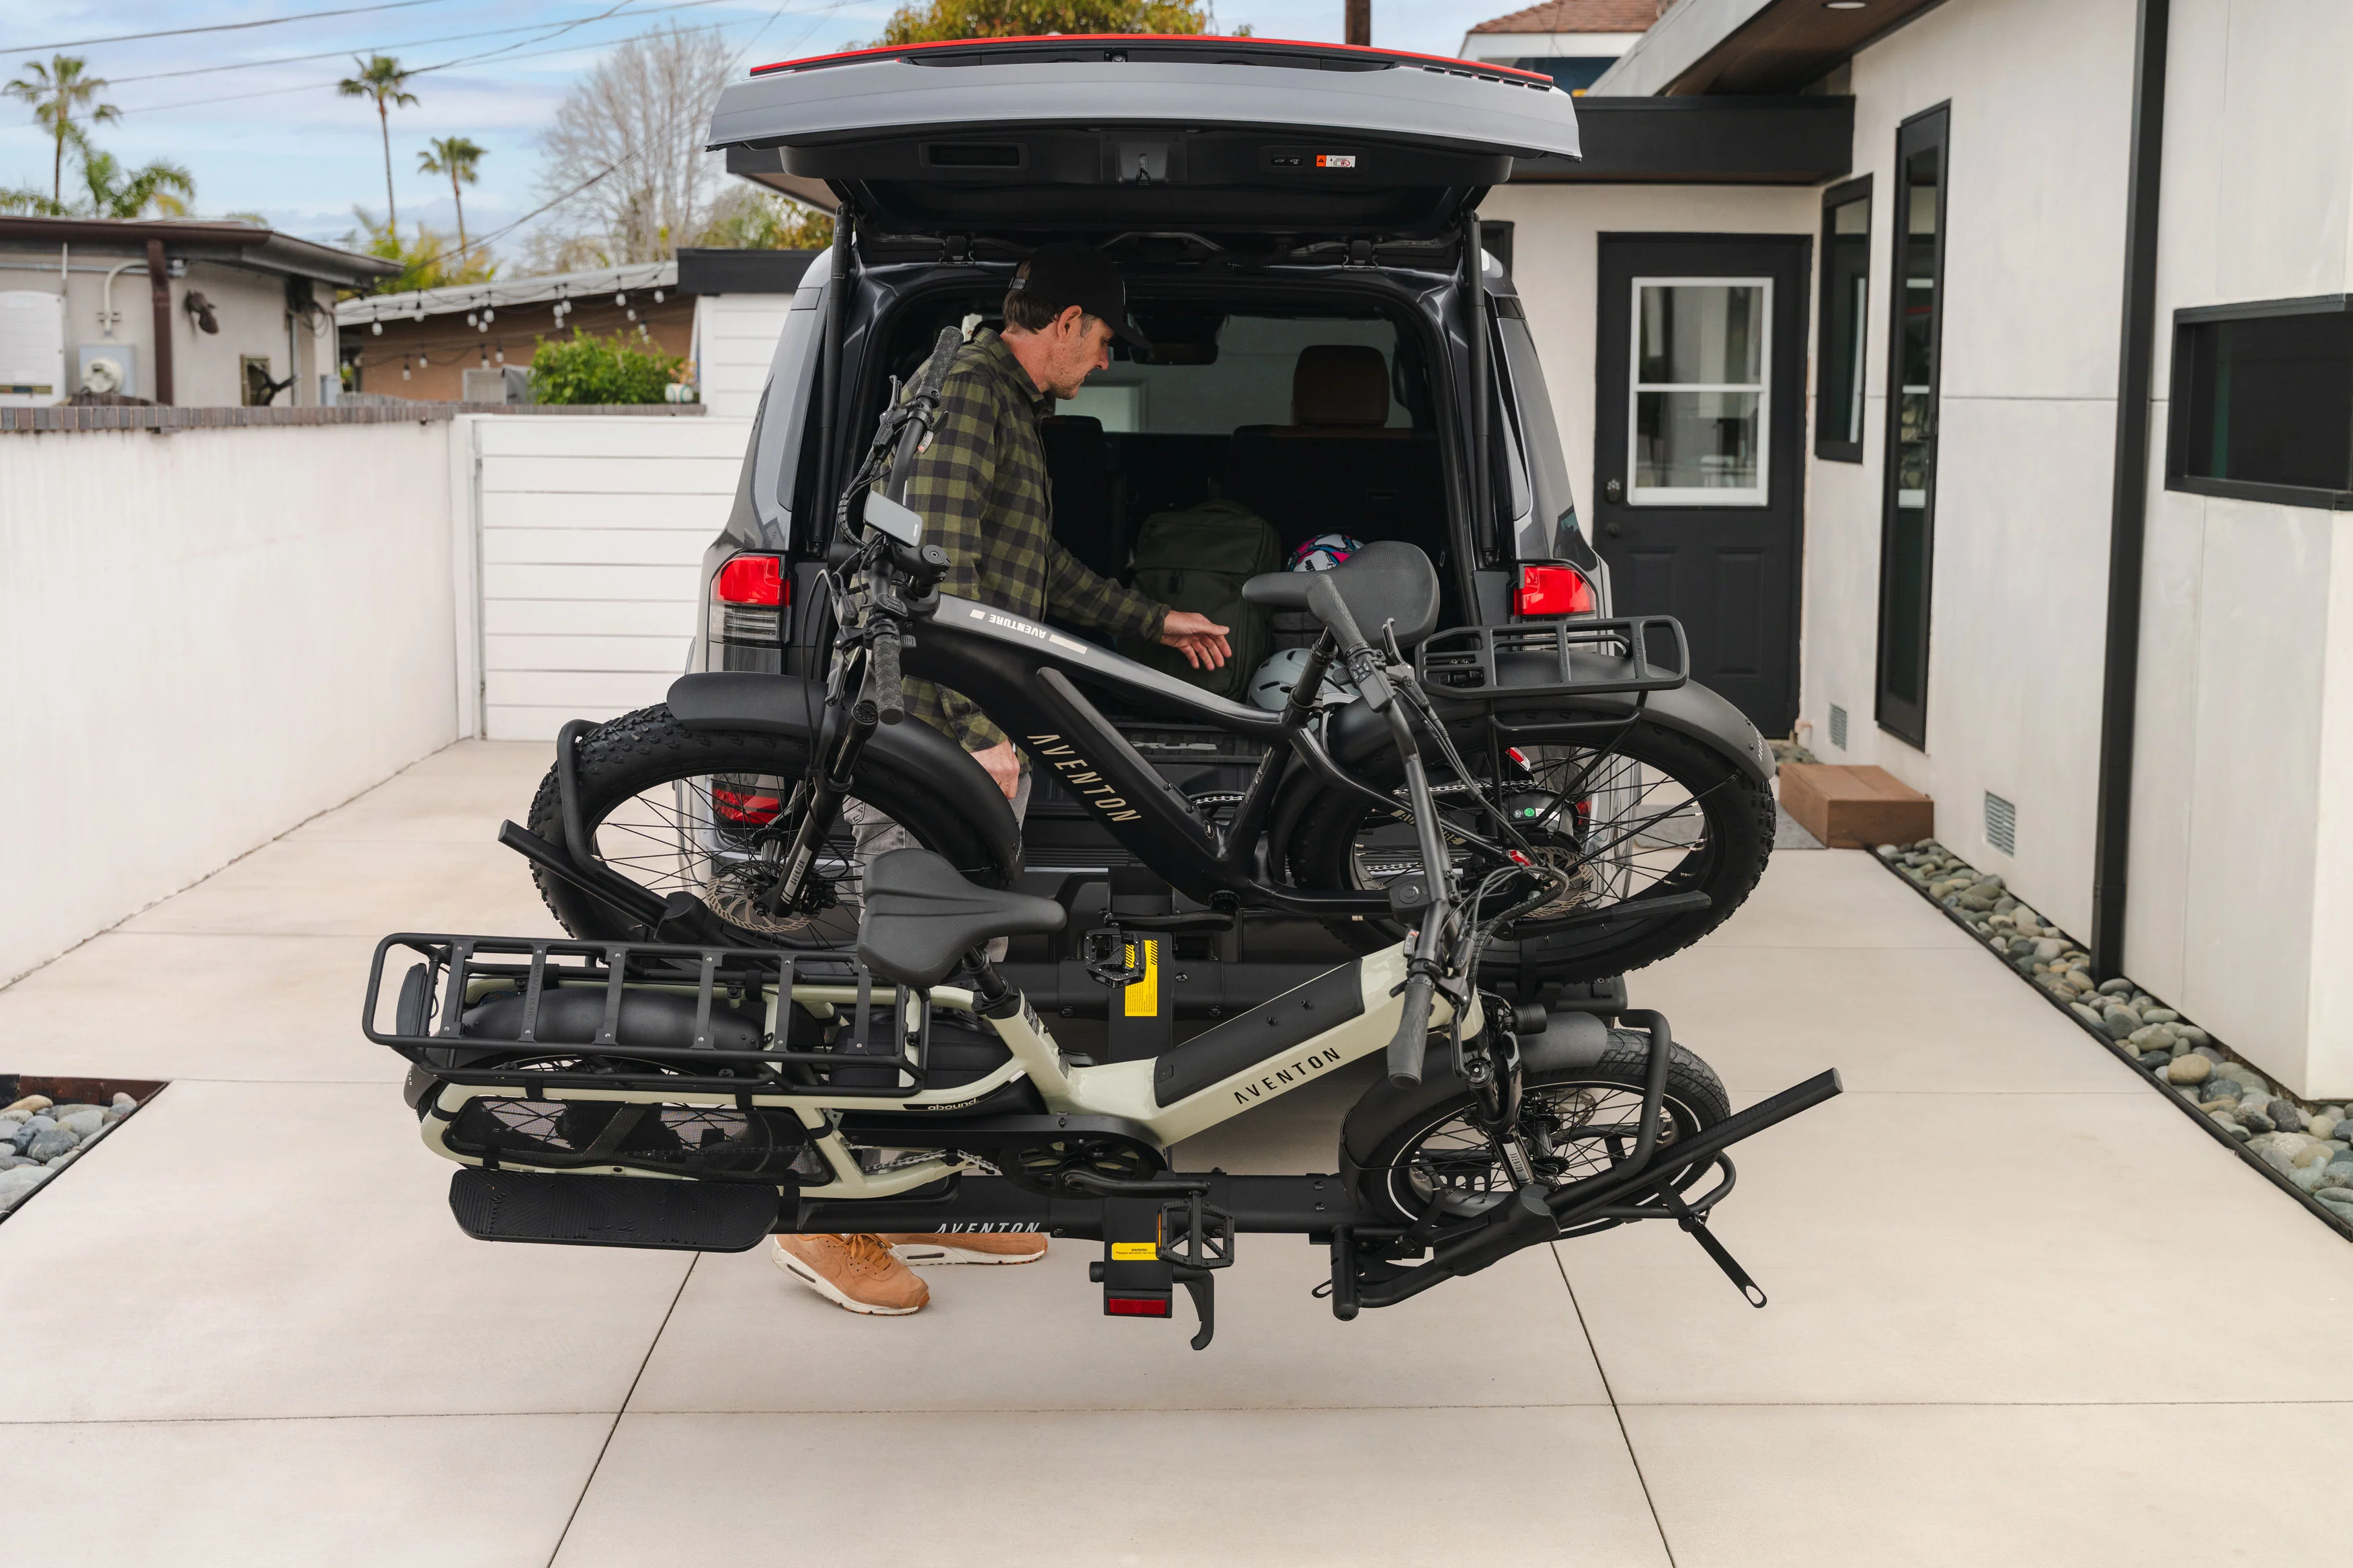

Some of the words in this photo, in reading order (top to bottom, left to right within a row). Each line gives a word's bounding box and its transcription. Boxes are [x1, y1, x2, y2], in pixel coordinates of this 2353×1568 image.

[989, 614, 1047, 638] AVENTURE
[1027, 735, 1142, 821] AVENTON
[790, 860, 805, 886] AVENTON
[1234, 1048, 1341, 1104] AVENTON
[928, 1098, 976, 1110] abound
[1509, 1153, 1524, 1172] AVENTON
[935, 1223, 1040, 1233] AVENTON
